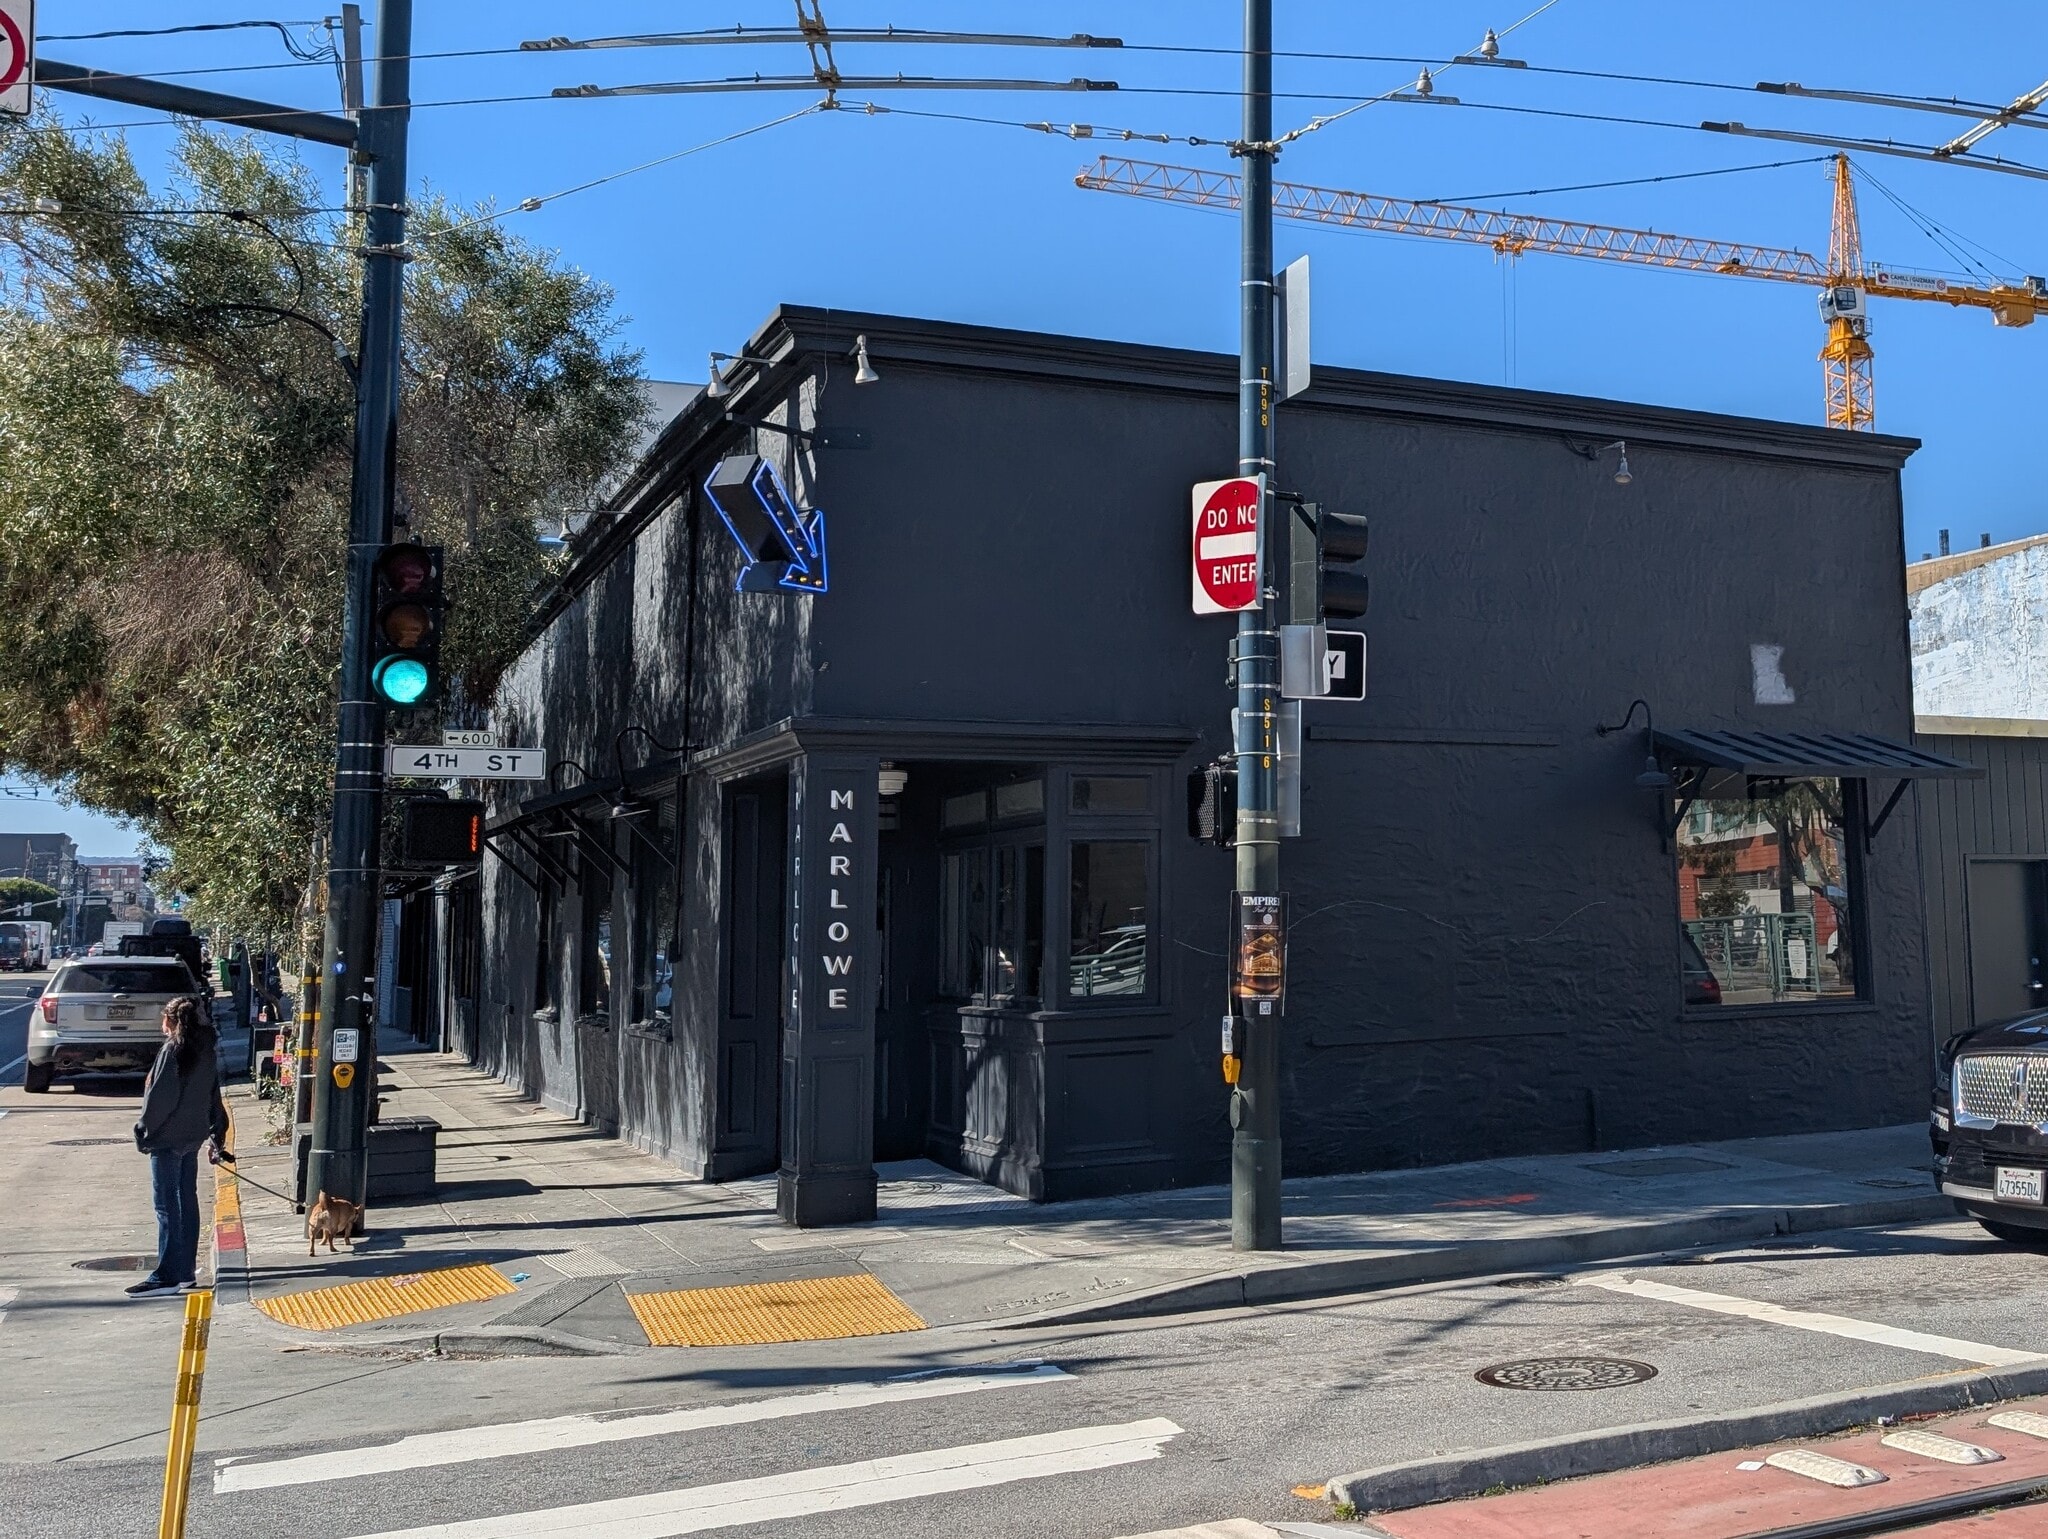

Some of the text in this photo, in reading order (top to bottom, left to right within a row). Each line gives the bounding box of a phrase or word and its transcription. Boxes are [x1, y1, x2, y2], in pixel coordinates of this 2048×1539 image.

[1890, 274, 1935, 285] CAHILL GUZMAN
[1207, 504, 1257, 529] DO NO
[461, 733, 491, 744] 600
[413, 753, 522, 772] 4TH ST
[822, 789, 854, 1010] MARLOWE
